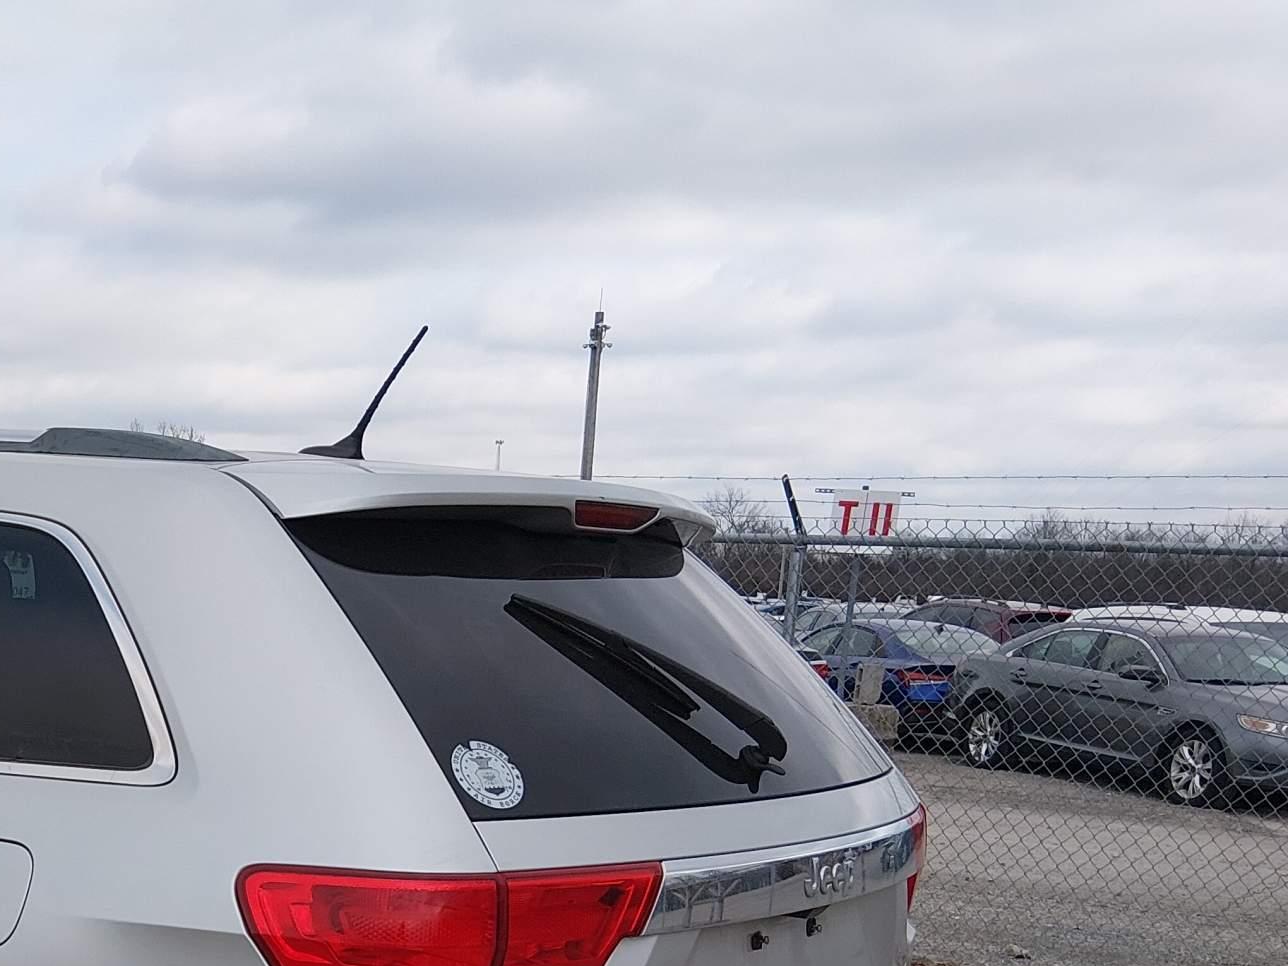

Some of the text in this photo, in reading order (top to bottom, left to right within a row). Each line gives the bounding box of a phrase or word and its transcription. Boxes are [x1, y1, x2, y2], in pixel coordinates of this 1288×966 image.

[473, 791, 521, 808] AIR FORCE
[803, 857, 855, 898] Jeep
